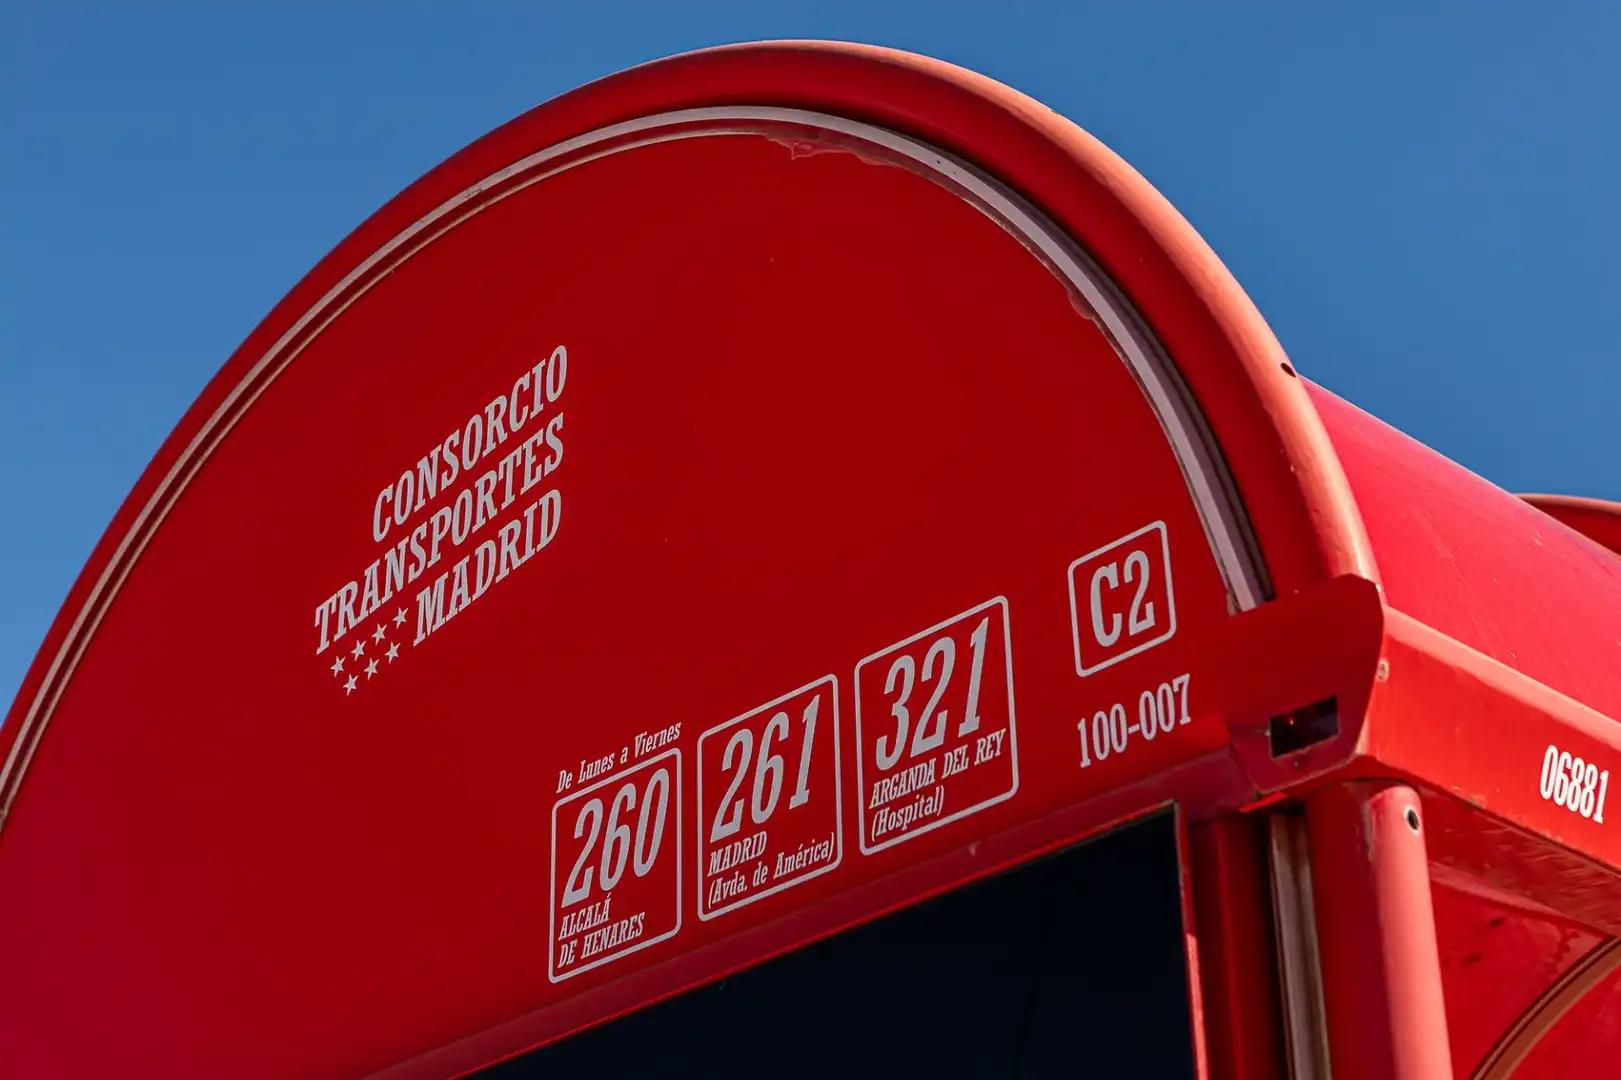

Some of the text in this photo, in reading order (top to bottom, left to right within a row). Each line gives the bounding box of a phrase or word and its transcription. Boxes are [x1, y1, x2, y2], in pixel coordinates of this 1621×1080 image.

[372, 344, 567, 542] CONSORCIO
[314, 412, 564, 655] TRANSPORTES
[413, 489, 562, 647] MADRID
[1090, 550, 1155, 647] C2
[875, 616, 989, 771] 321
[1077, 673, 1191, 768] 100-007
[556, 721, 682, 794] De Lunes a Viernes
[709, 694, 820, 843] 261
[869, 728, 1007, 809] ARGANDA DEL REY
[1539, 744, 1610, 824] 06881
[561, 768, 670, 909] 260
[707, 831, 767, 877] MADRID
[871, 785, 944, 842] (Hospital)
[708, 831, 835, 909] (Avda. de América)
[557, 911, 646, 968] DE HENARES
[558, 891, 611, 941] ALCALÁ
